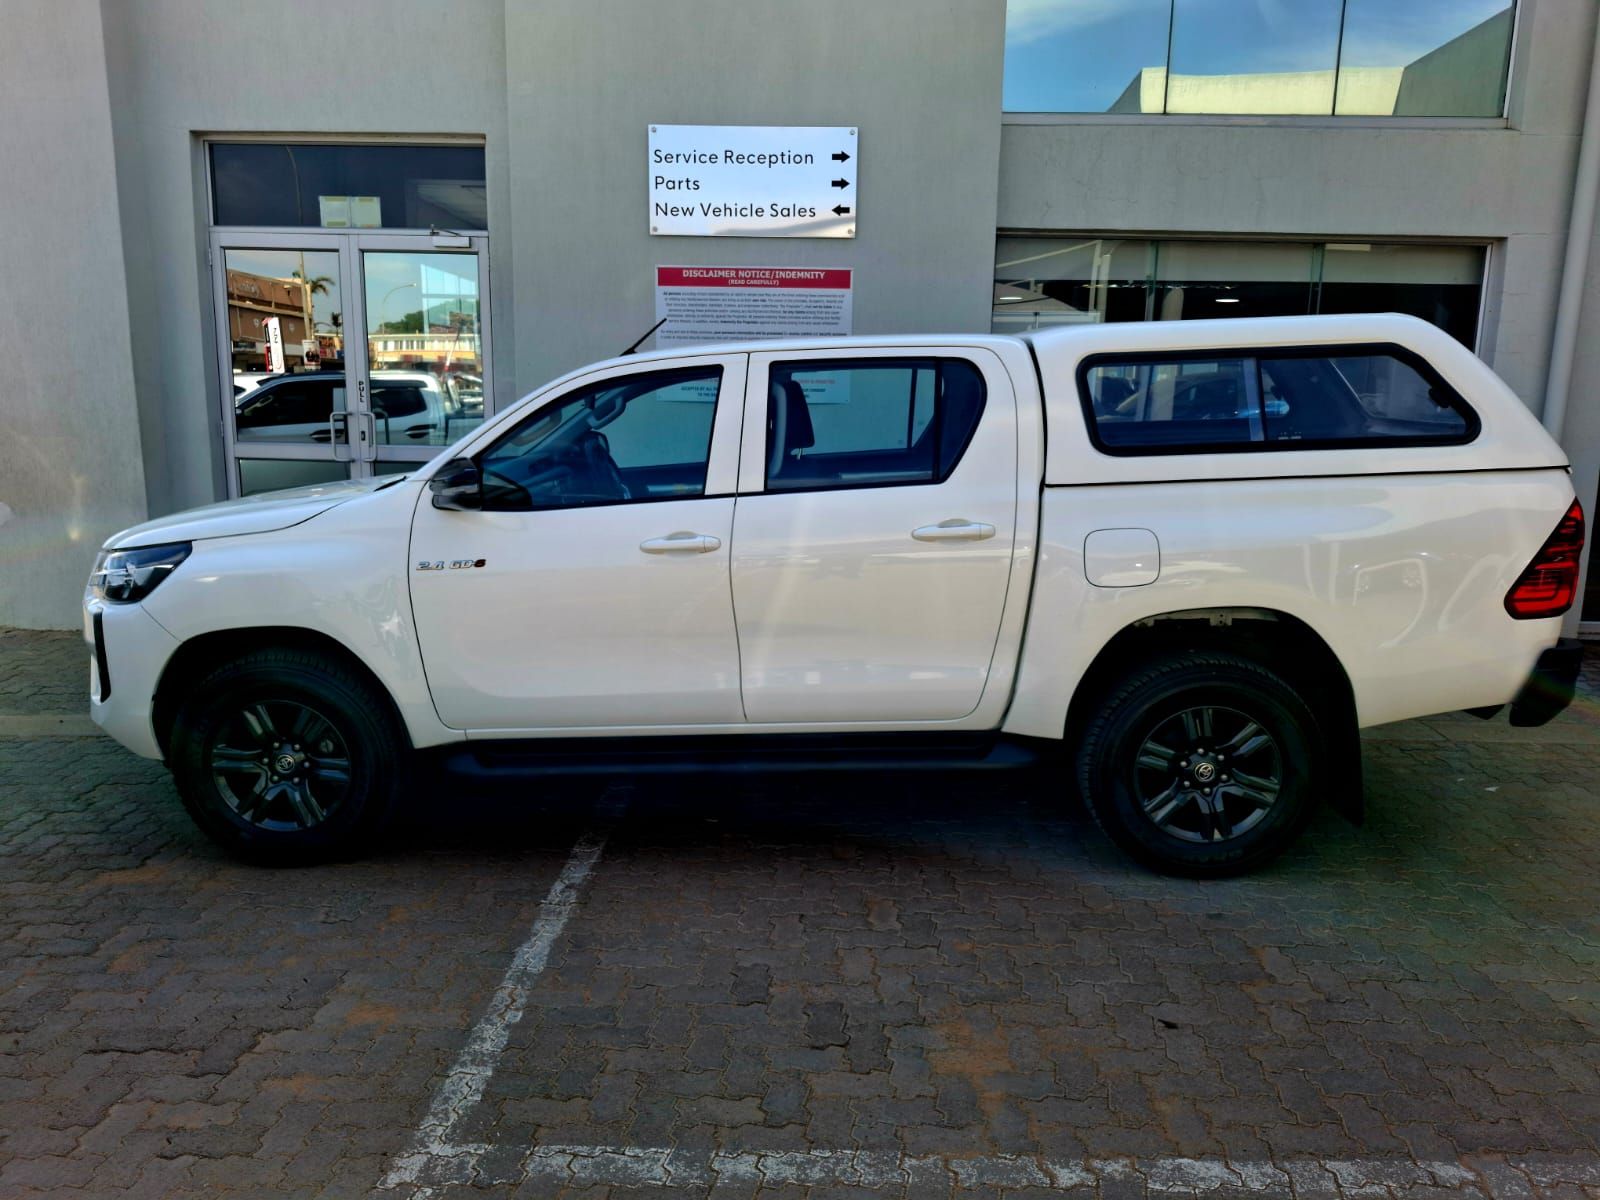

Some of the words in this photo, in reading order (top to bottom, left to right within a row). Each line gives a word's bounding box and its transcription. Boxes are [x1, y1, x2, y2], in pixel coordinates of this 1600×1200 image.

[653, 149, 719, 164] Service
[724, 150, 814, 168] Reception
[654, 175, 700, 190] Parts
[655, 202, 695, 216] New
[700, 203, 765, 217] Vehicle
[770, 203, 816, 218] Sales
[682, 269, 737, 278] DISCLAIMER
[738, 270, 826, 279] NOTICE/INDEMNITY
[416, 560, 445, 571] 2.4
